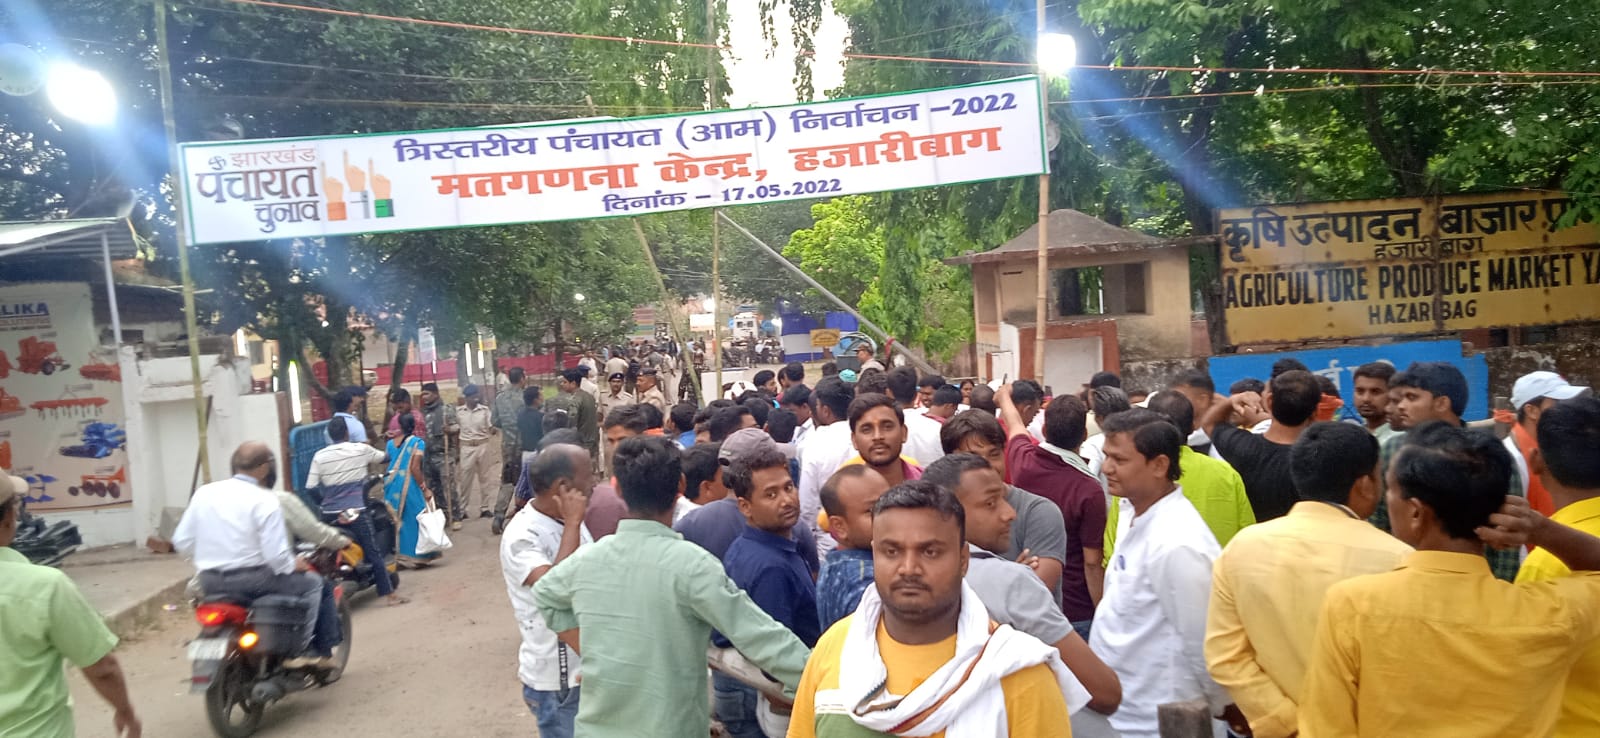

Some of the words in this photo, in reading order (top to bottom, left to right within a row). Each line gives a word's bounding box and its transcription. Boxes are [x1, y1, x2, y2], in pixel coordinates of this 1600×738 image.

[394, 134, 537, 163] त्रिस्तरीय
[549, 127, 661, 153] पंचायत
[676, 111, 777, 150] (आम)
[789, 103, 919, 133] निर्वाचन
[229, 144, 316, 168] झारखंड
[431, 164, 638, 199] मतगणना
[654, 152, 768, 182] केन्द्र,
[788, 126, 1002, 172] हजारीबाग
[254, 200, 320, 233] चुनाव
[603, 191, 687, 214] दिनांक
[721, 179, 842, 203] 17.05.2022
[1222, 207, 1287, 262] कृषि
[1439, 201, 1537, 235] बाजार
[1225, 266, 1368, 309] AGRICULTURE
[1379, 261, 1480, 299] PRODUCE
[1488, 253, 1575, 291] MARKET
[1369, 300, 1476, 325] HAZARIBAG
